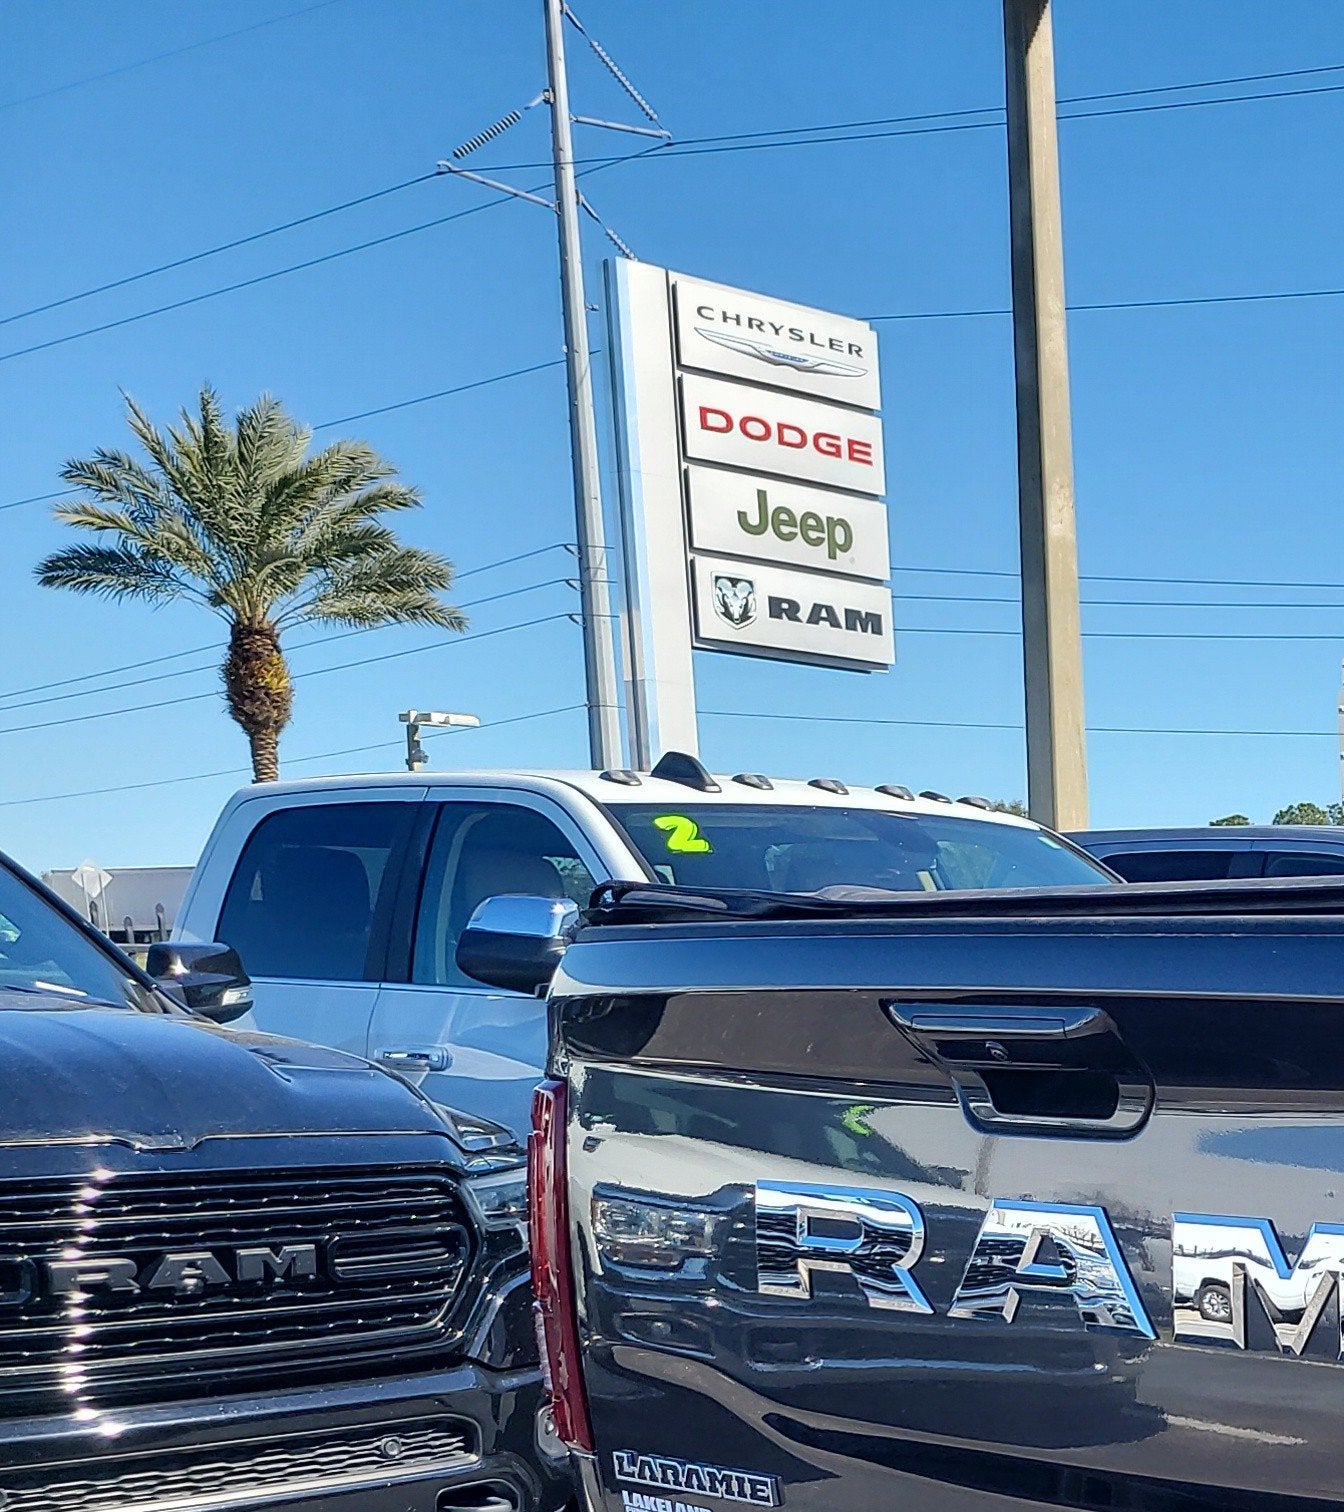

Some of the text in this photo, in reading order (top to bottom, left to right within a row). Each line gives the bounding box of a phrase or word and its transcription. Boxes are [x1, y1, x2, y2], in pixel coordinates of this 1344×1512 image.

[696, 305, 865, 359] CHRYSLER
[698, 405, 874, 467] DODGE
[736, 488, 854, 560] Jeep
[767, 595, 884, 636] RAM
[653, 815, 713, 853] 2
[47, 1243, 317, 1293] RAM
[612, 1450, 779, 1507] LARAMIE
